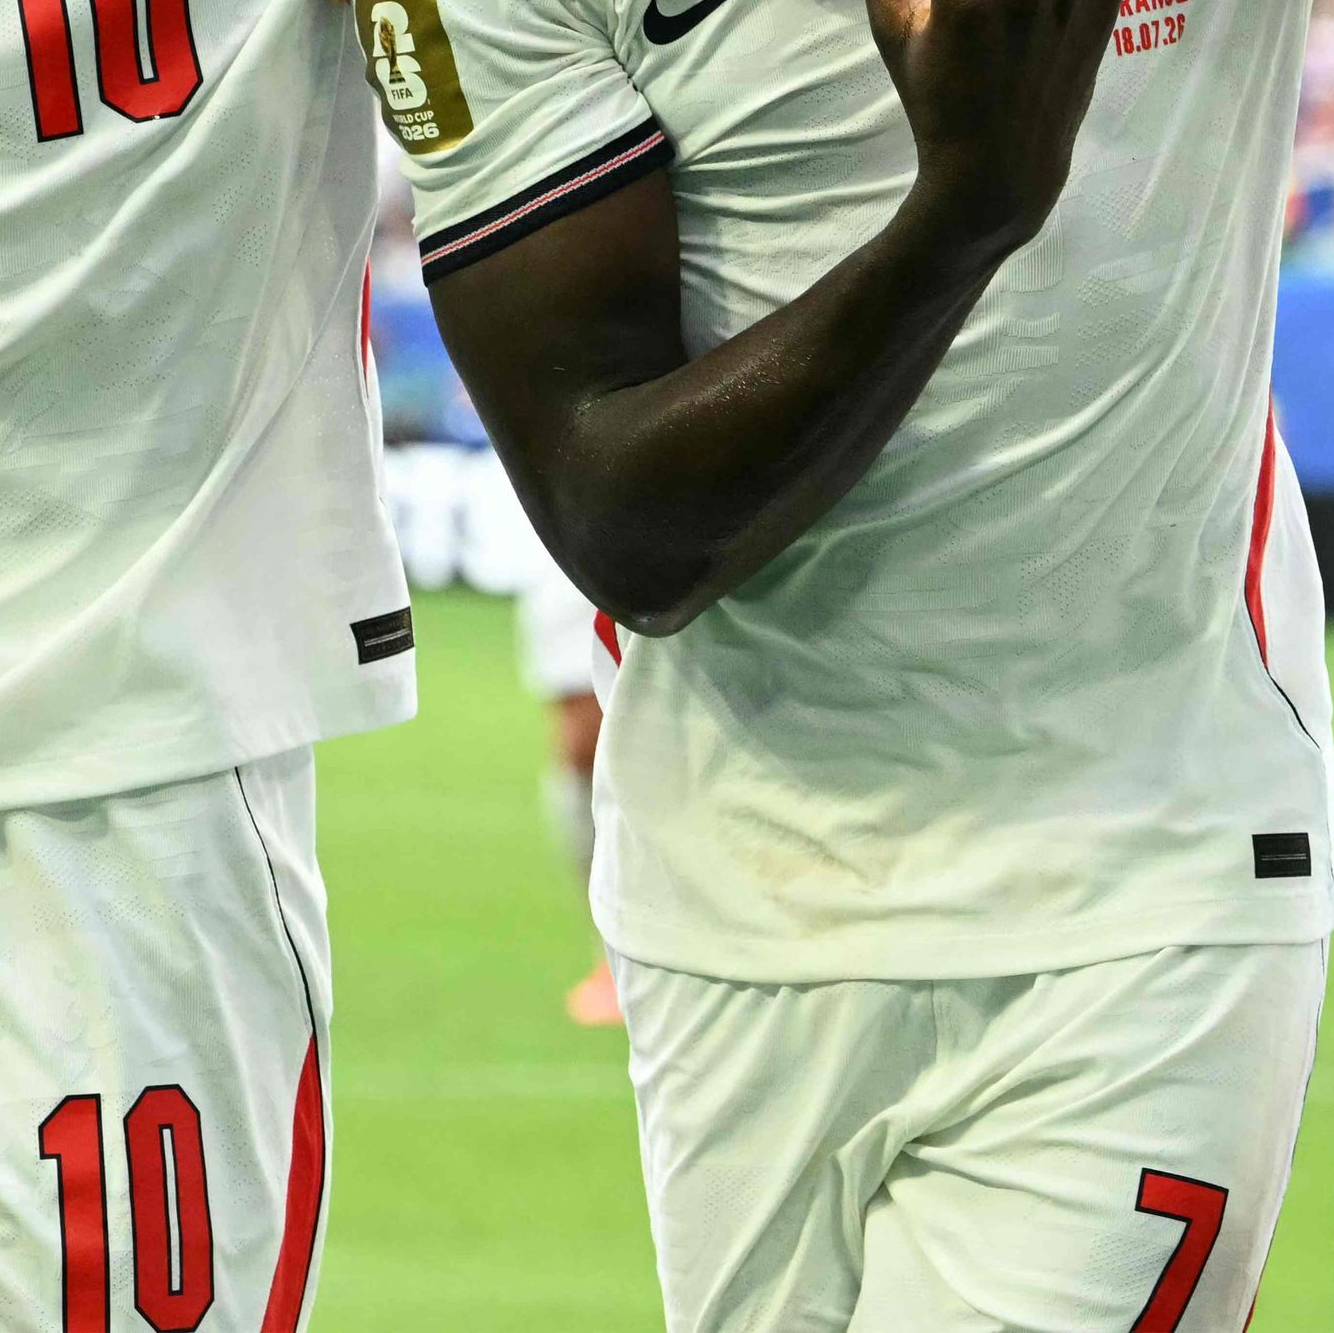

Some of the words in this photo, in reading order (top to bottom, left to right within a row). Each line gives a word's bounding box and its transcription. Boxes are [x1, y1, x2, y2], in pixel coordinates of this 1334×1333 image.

[1113, 13, 1185, 57] 18.07.26
[391, 87, 414, 100] FIFA
[414, 110, 434, 122] CUP
[38, 1084, 214, 1333] 10
[1128, 1167, 1229, 1333] 7
